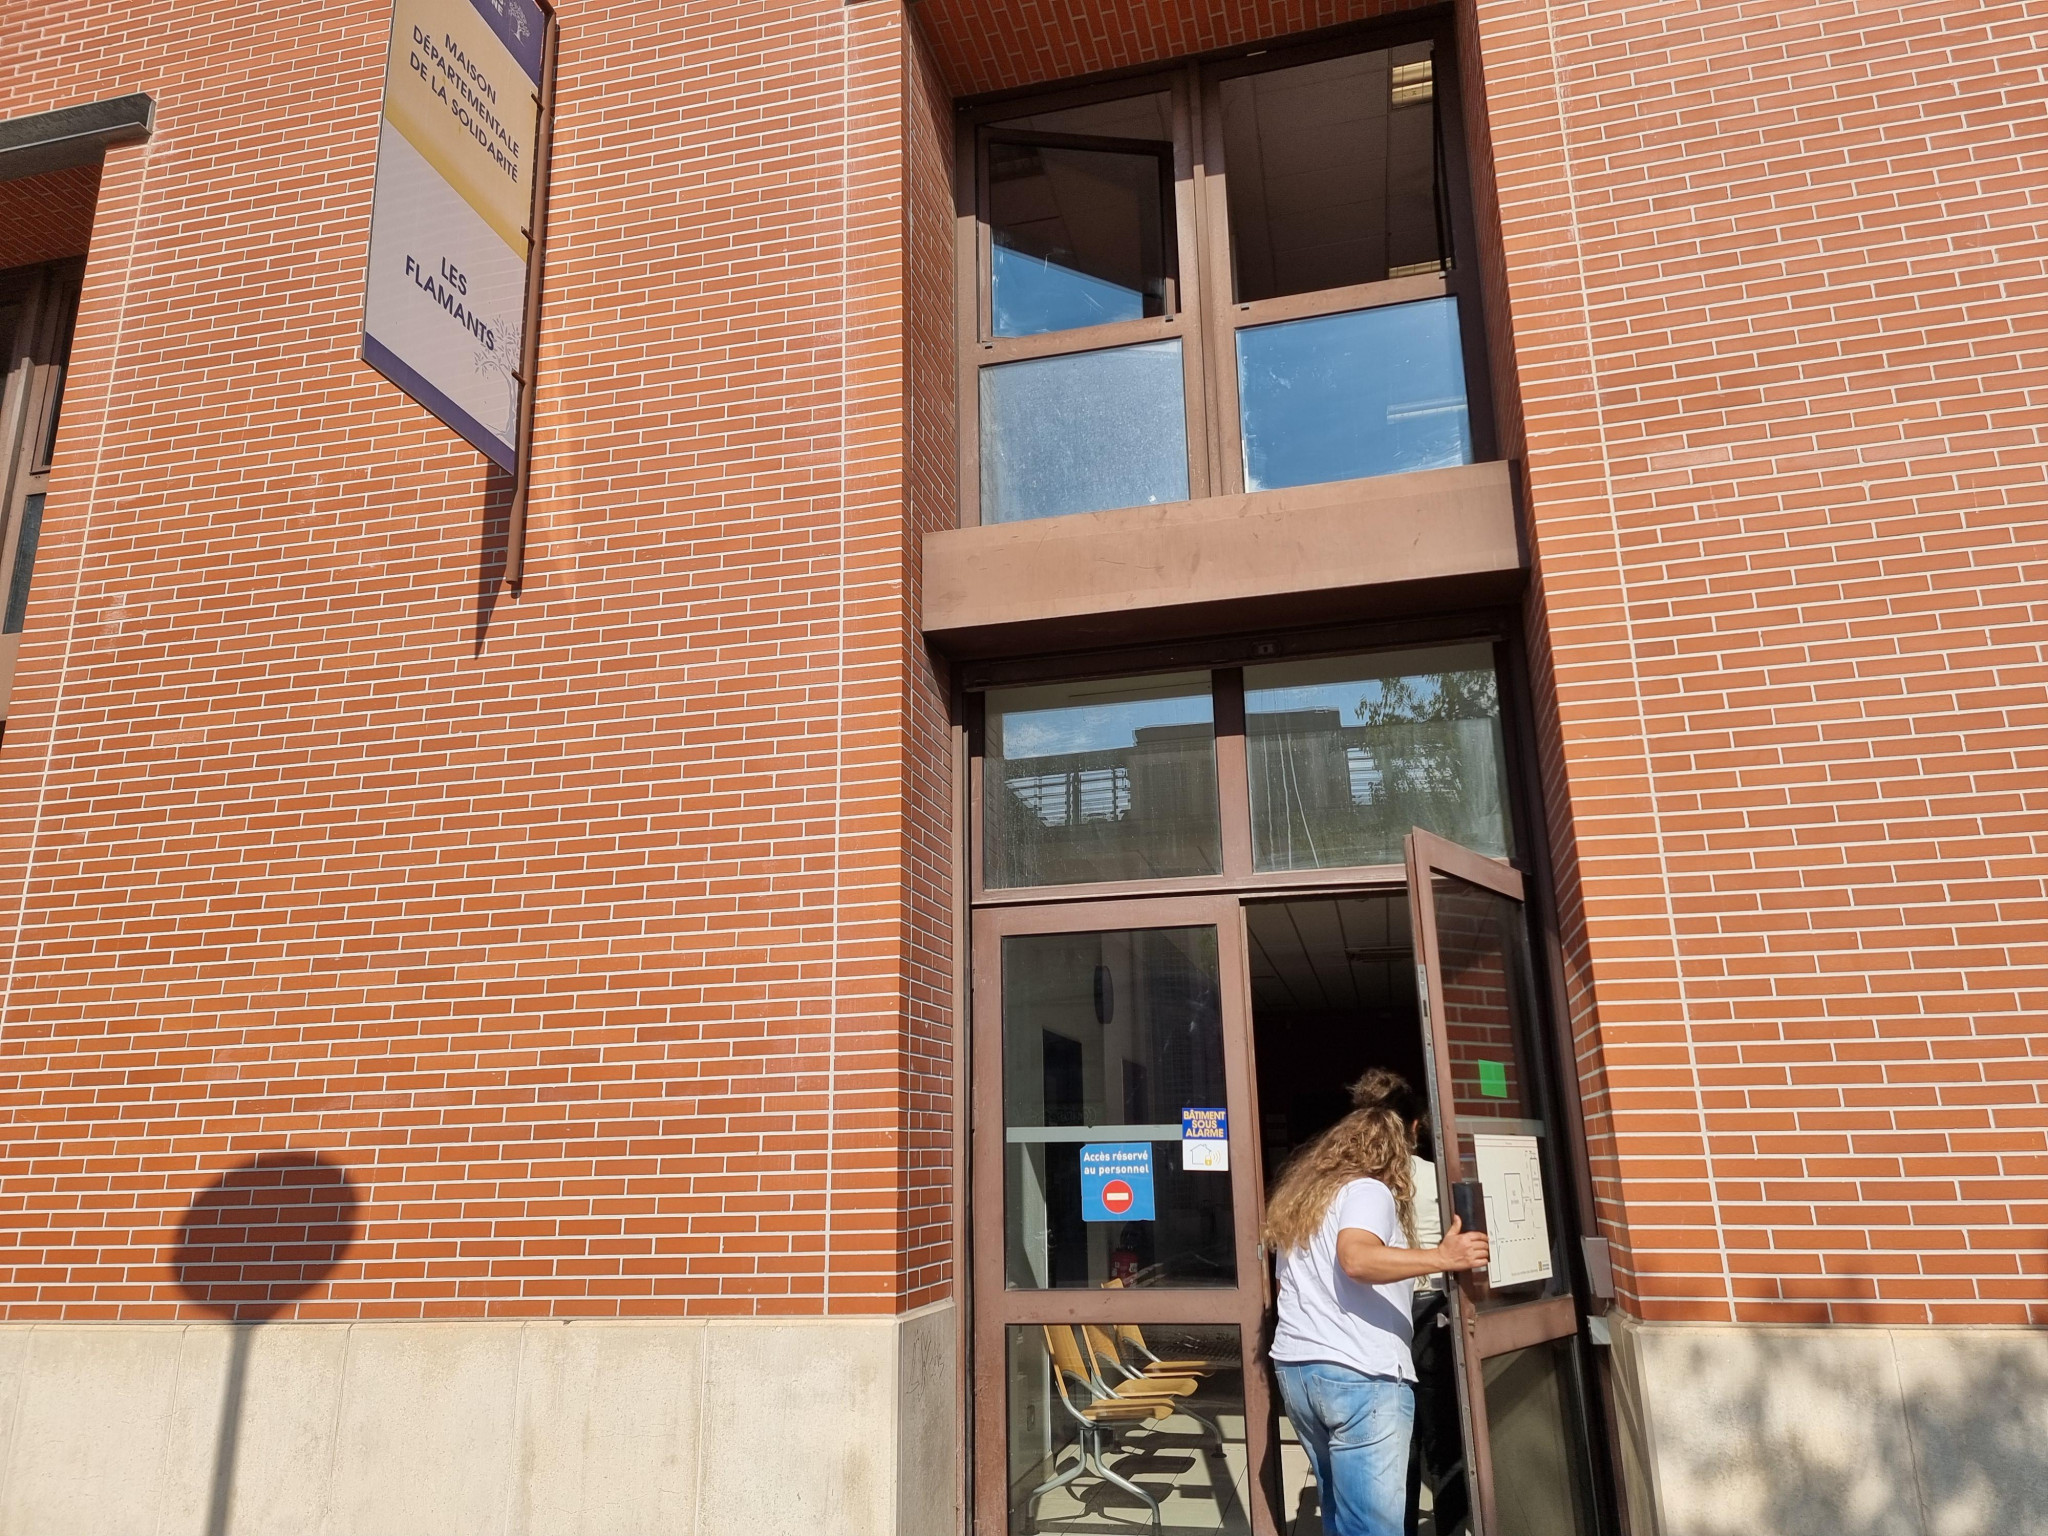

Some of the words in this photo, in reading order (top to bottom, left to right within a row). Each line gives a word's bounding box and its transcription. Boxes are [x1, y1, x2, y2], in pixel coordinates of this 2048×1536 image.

[445, 33, 497, 105] MAISON
[413, 25, 519, 159] DÉPARTEMENTALE
[410, 51, 427, 82] DE
[431, 75, 448, 105] LA
[451, 99, 518, 183] SOLIDARITÉ
[441, 256, 468, 296] LES
[405, 254, 495, 351] FLAMANTS
[1183, 1109, 1226, 1120] BÂTIMENT
[1191, 1120, 1218, 1129] SOUS
[1185, 1128, 1224, 1138] ALARME
[1083, 1152, 1110, 1162] Accès
[1112, 1150, 1148, 1161] réservé
[1083, 1167, 1096, 1175] au
[1098, 1164, 1149, 1177] personnel
